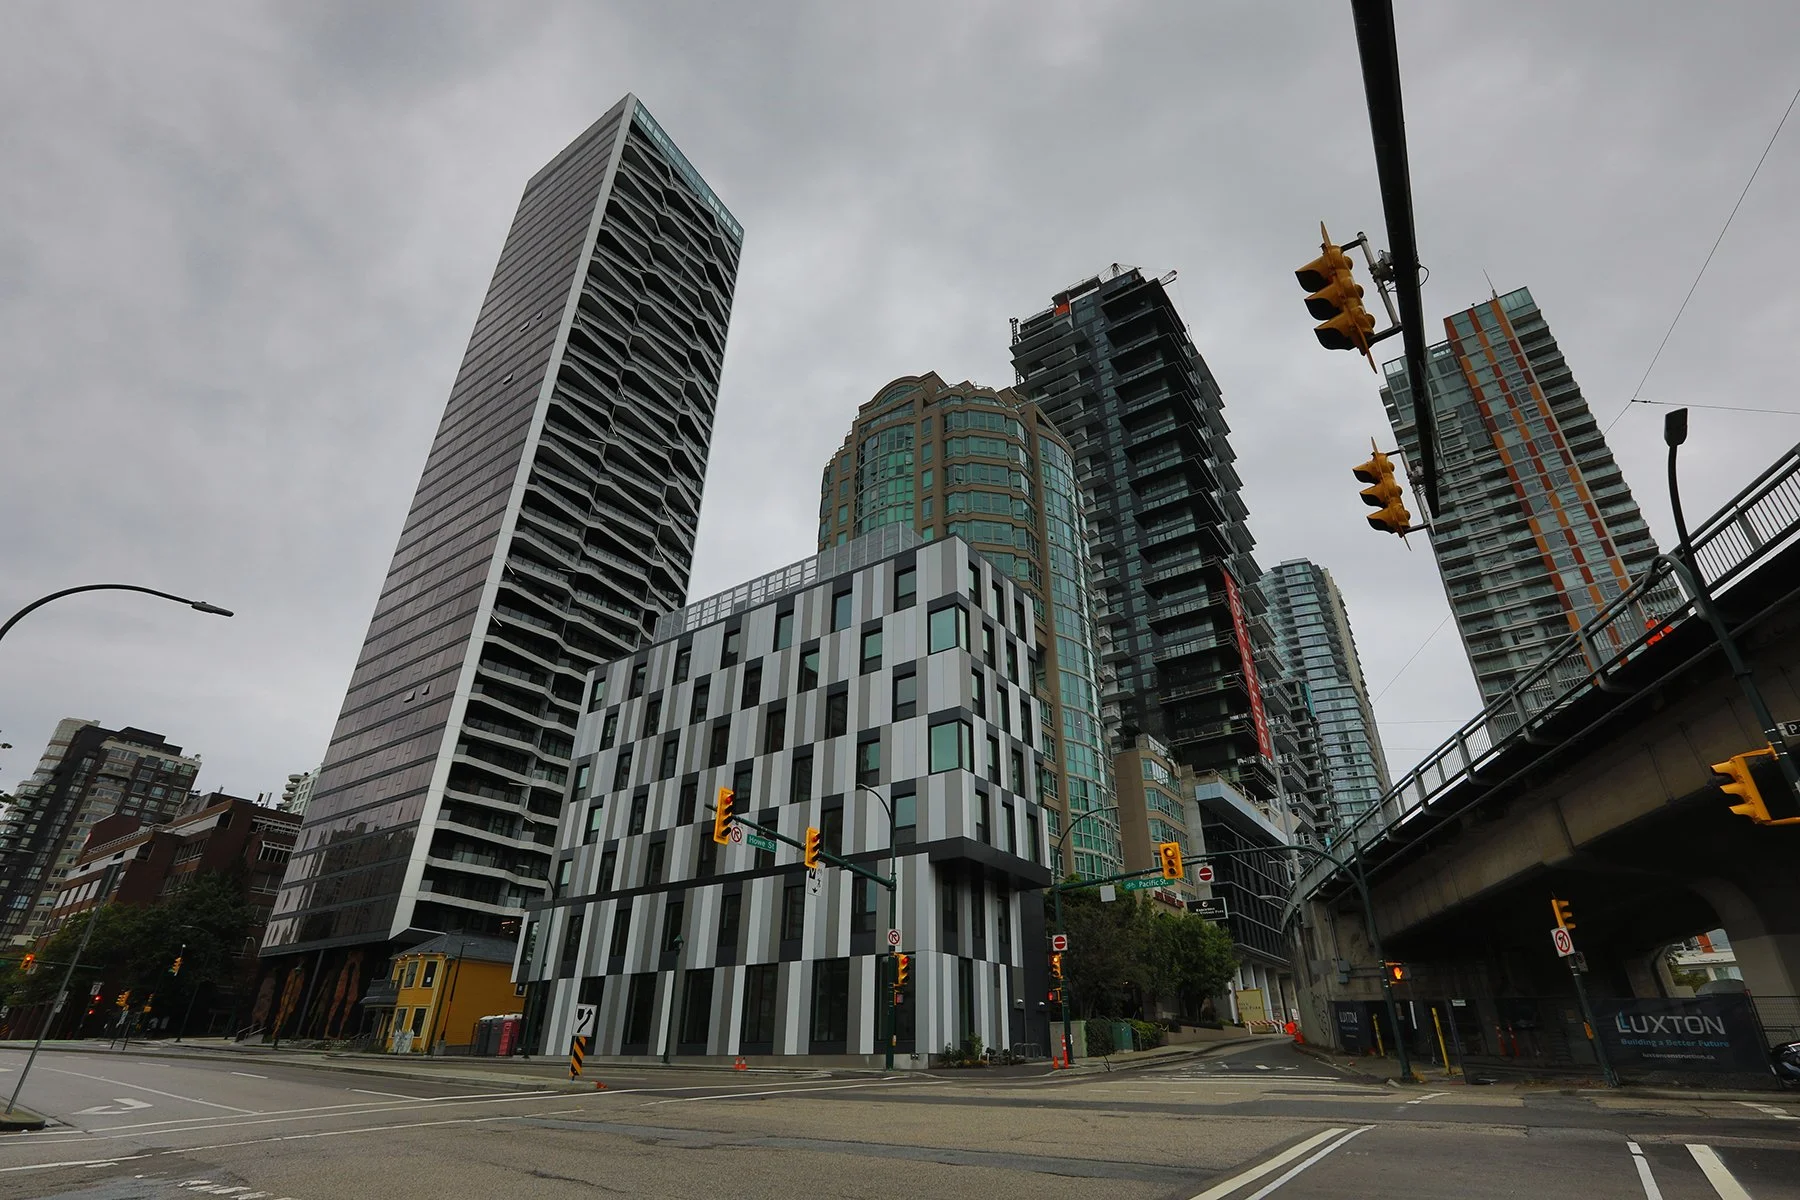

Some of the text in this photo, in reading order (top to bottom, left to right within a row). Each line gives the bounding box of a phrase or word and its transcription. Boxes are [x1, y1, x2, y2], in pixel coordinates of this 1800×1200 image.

[1228, 582, 1270, 749] NOW SELLING
[1788, 723, 1800, 734] P
[749, 835, 775, 850] Howe St
[1138, 878, 1169, 888] Pacific St.
[1615, 1011, 1727, 1035] LUXTON
[1620, 1038, 1657, 1047] Building
[1665, 1039, 1695, 1047] Better
[1698, 1039, 1730, 1047] Future
